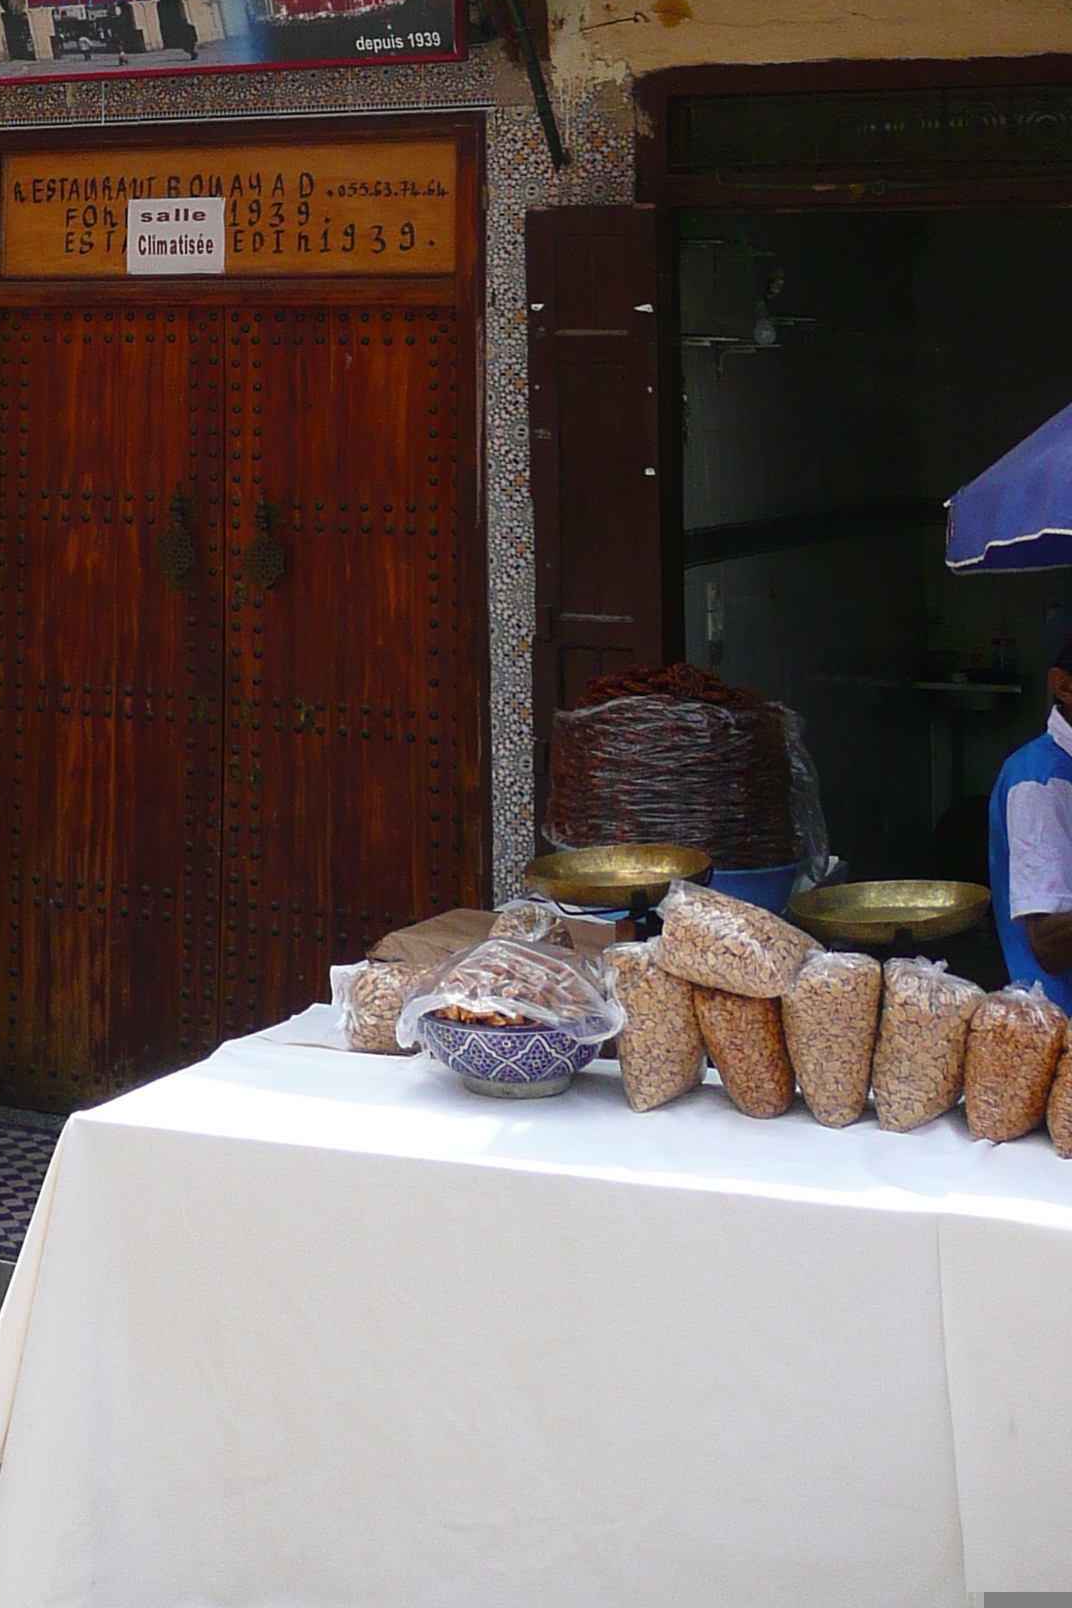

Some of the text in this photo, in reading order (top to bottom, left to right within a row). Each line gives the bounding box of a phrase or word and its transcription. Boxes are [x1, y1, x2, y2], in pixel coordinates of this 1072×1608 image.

[355, 31, 441, 54] depuis 1939
[140, 207, 207, 223] salle
[138, 233, 214, 256] Climatisée
